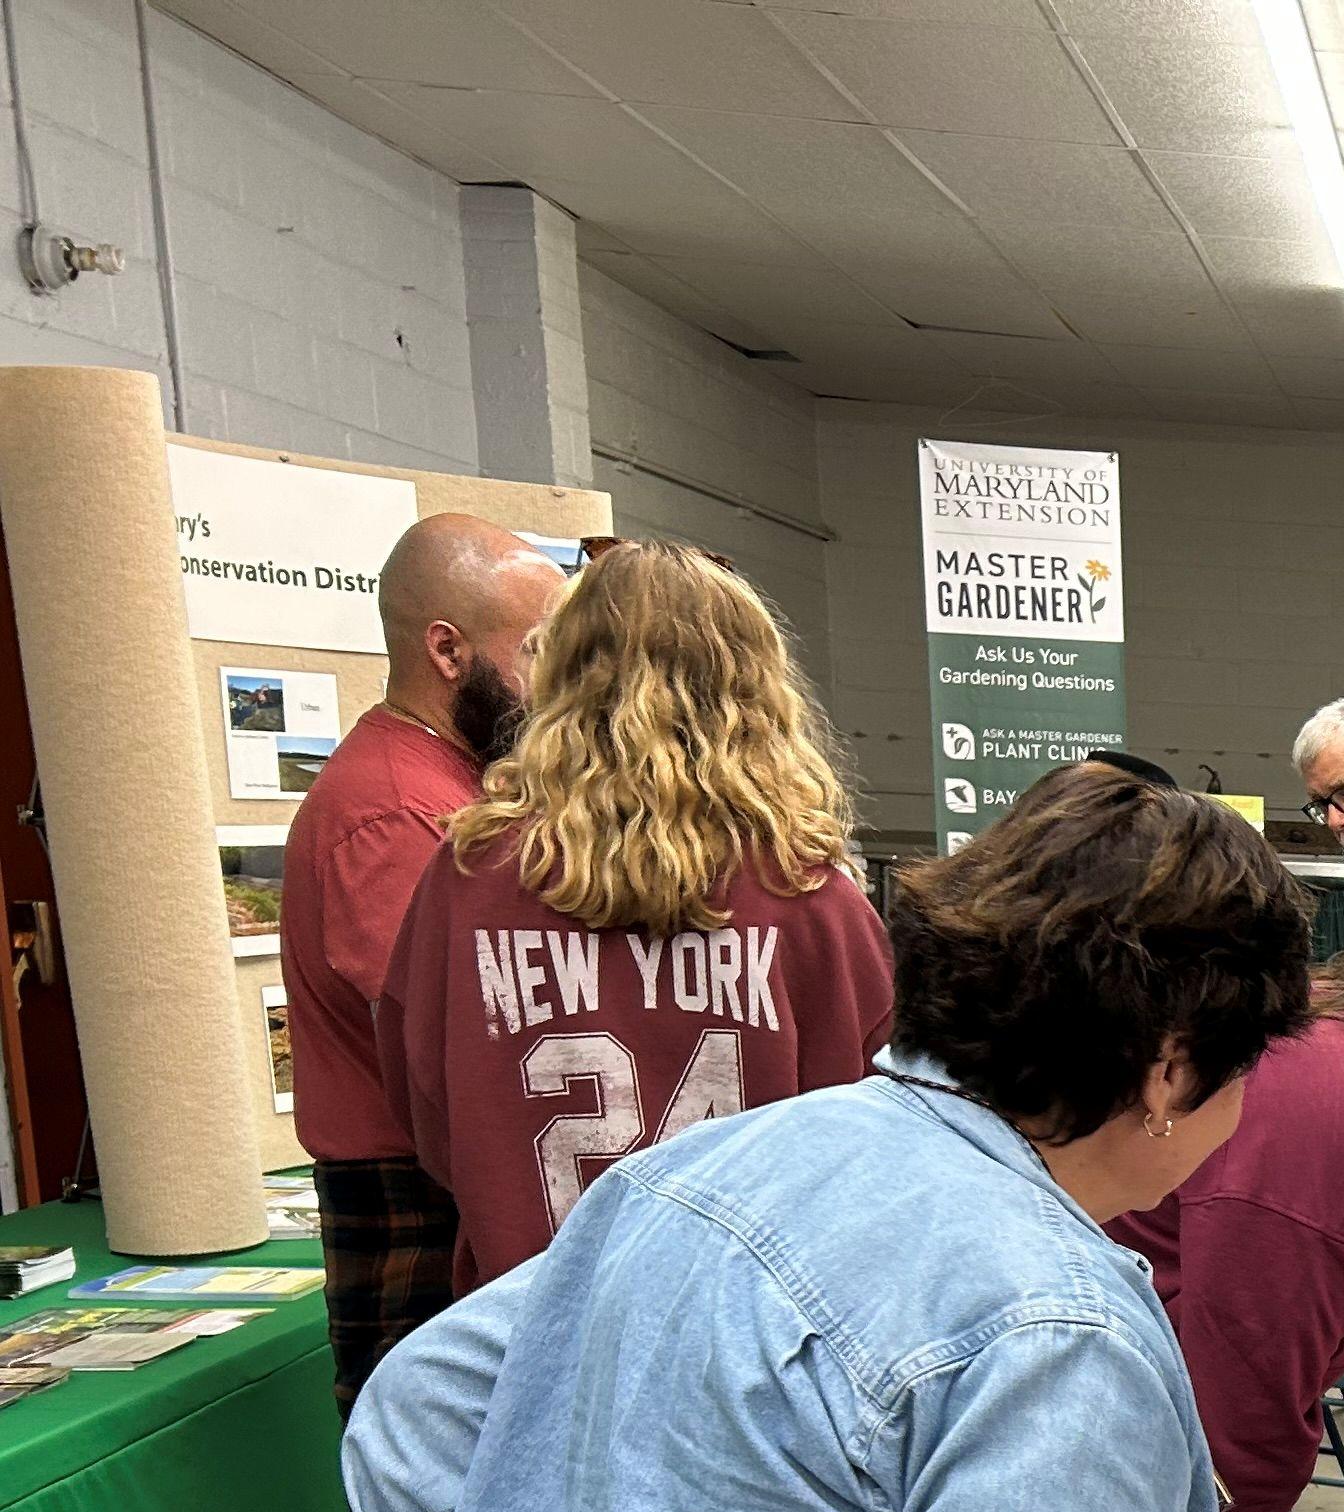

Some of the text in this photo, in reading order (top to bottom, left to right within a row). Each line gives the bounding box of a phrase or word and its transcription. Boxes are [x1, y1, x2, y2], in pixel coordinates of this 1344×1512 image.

[934, 459, 1108, 482] UNIVERSITY OF
[934, 471, 1110, 505] MARYLAND
[174, 512, 211, 542] ry's
[934, 498, 1110, 527] EXTENSION
[180, 554, 307, 588] onservation
[936, 550, 1069, 580] MASTER
[938, 581, 1083, 623] GARDENER
[975, 645, 1078, 666] Ask Us Your
[939, 667, 1116, 692] Gardening Questions
[982, 728, 1122, 745] ASK A MASTER GARDENER
[983, 742, 1041, 760] PLANT
[983, 789, 1016, 805] BAY
[474, 926, 780, 1040] NEW YORK
[520, 1029, 746, 1237] 24
